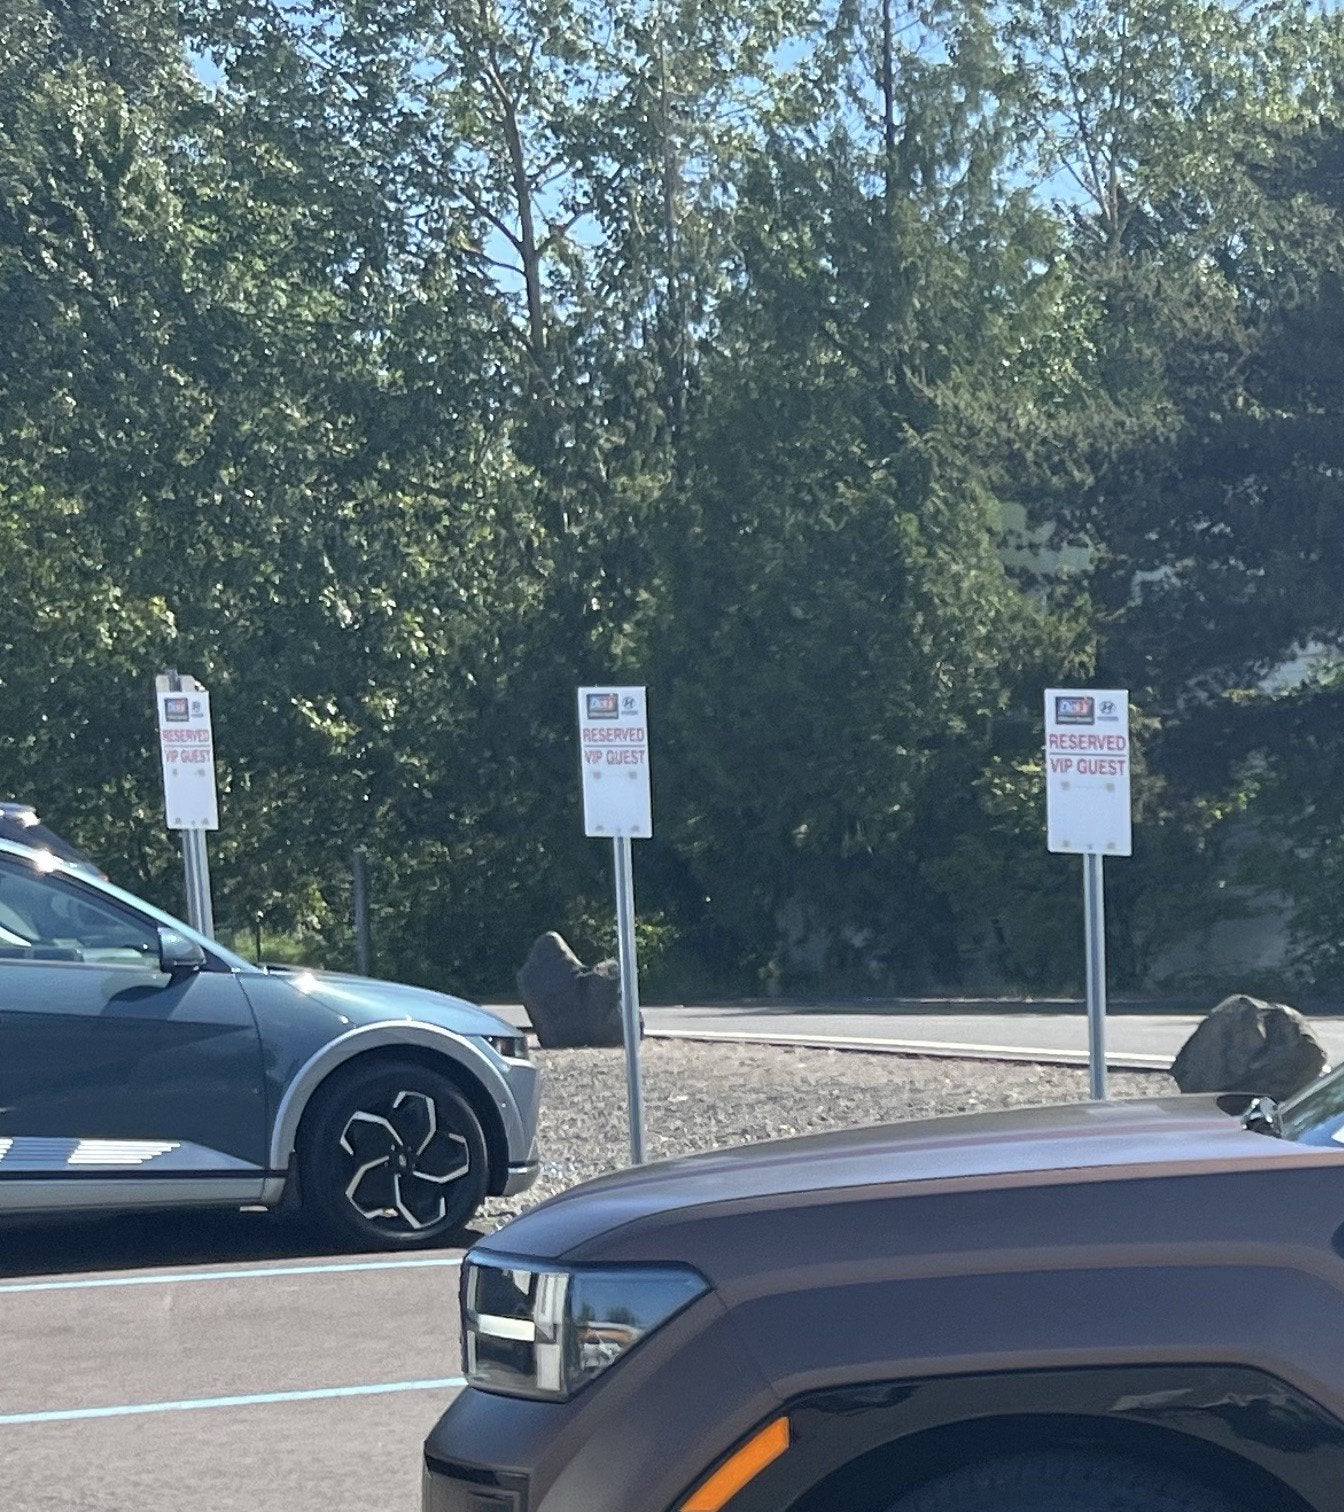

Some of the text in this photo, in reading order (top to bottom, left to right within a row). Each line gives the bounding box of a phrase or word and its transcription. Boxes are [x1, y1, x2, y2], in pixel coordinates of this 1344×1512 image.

[163, 729, 209, 742] RESERVED
[583, 727, 645, 742] RESERVED
[1049, 733, 1126, 751] RESERVED
[166, 750, 211, 763] VIP GUEST
[584, 750, 645, 765] VIP GUEST
[1050, 758, 1126, 775] VIP GUEST
